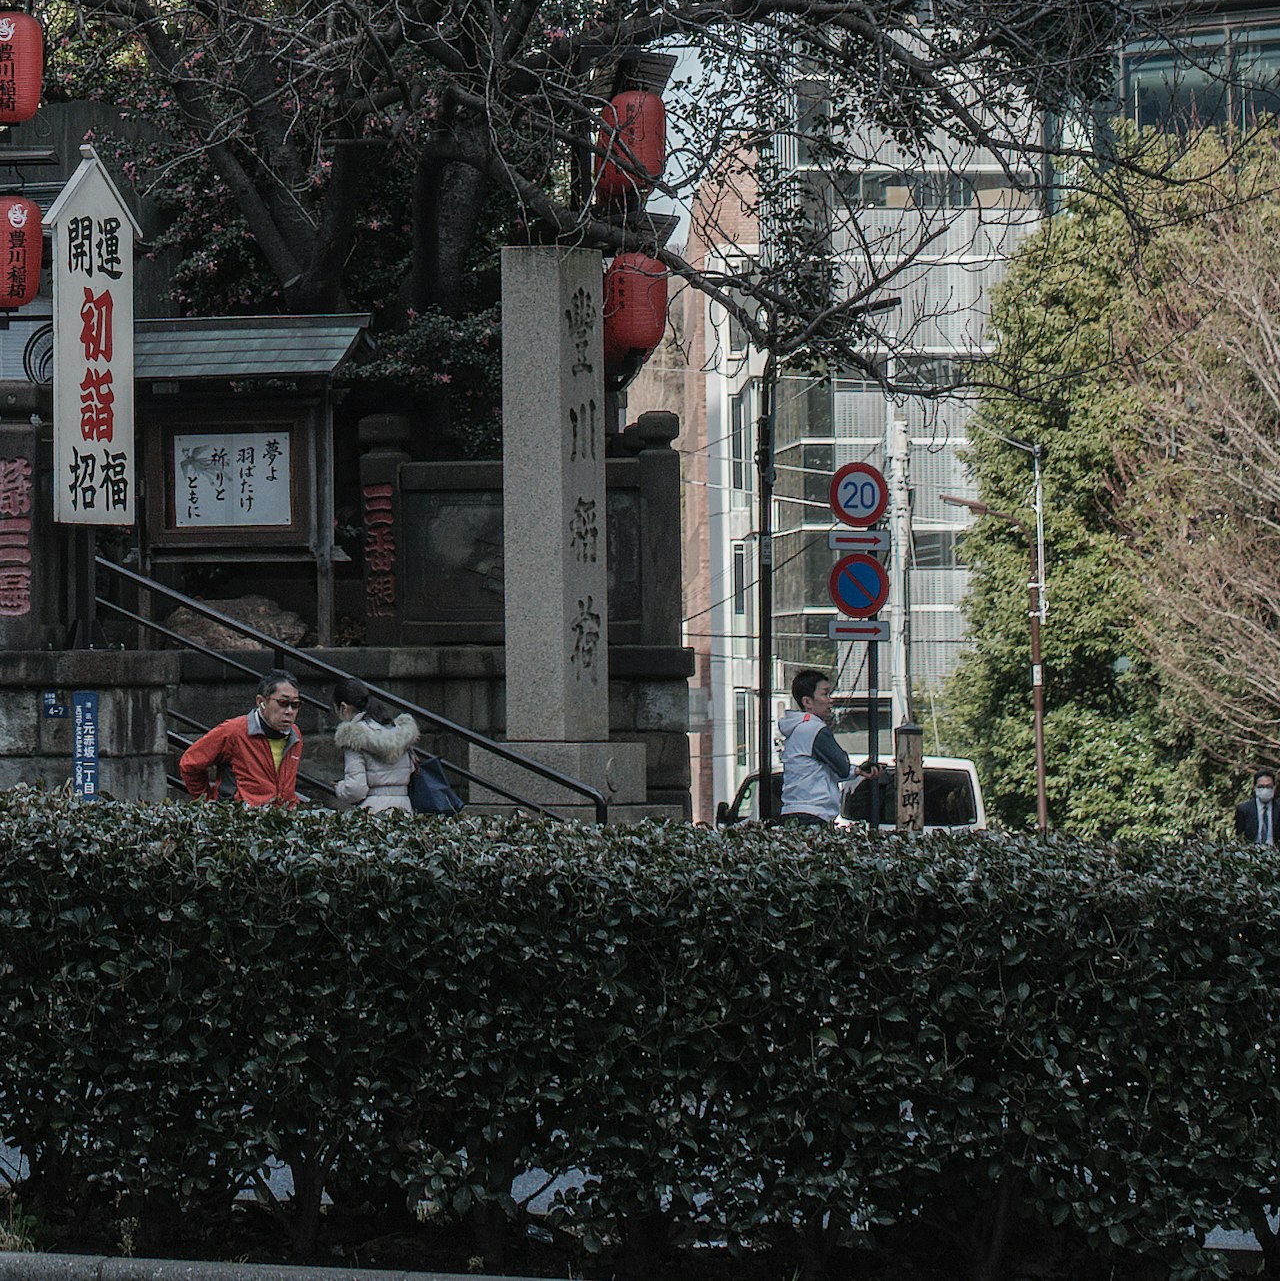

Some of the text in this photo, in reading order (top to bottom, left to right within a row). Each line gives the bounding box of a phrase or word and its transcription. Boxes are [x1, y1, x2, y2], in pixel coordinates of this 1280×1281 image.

[7, 231, 27, 298] 豊川稲荷
[67, 216, 123, 280] 開運
[80, 286, 115, 443] 初詣
[68, 445, 129, 512] 招福
[211, 448, 228, 501] 祈りと
[236, 447, 256, 512] 羽ばたけ
[262, 439, 283, 482] 夢よ
[187, 476, 200, 519] ともに
[842, 481, 876, 509] 20
[48, 707, 64, 716] 4-7
